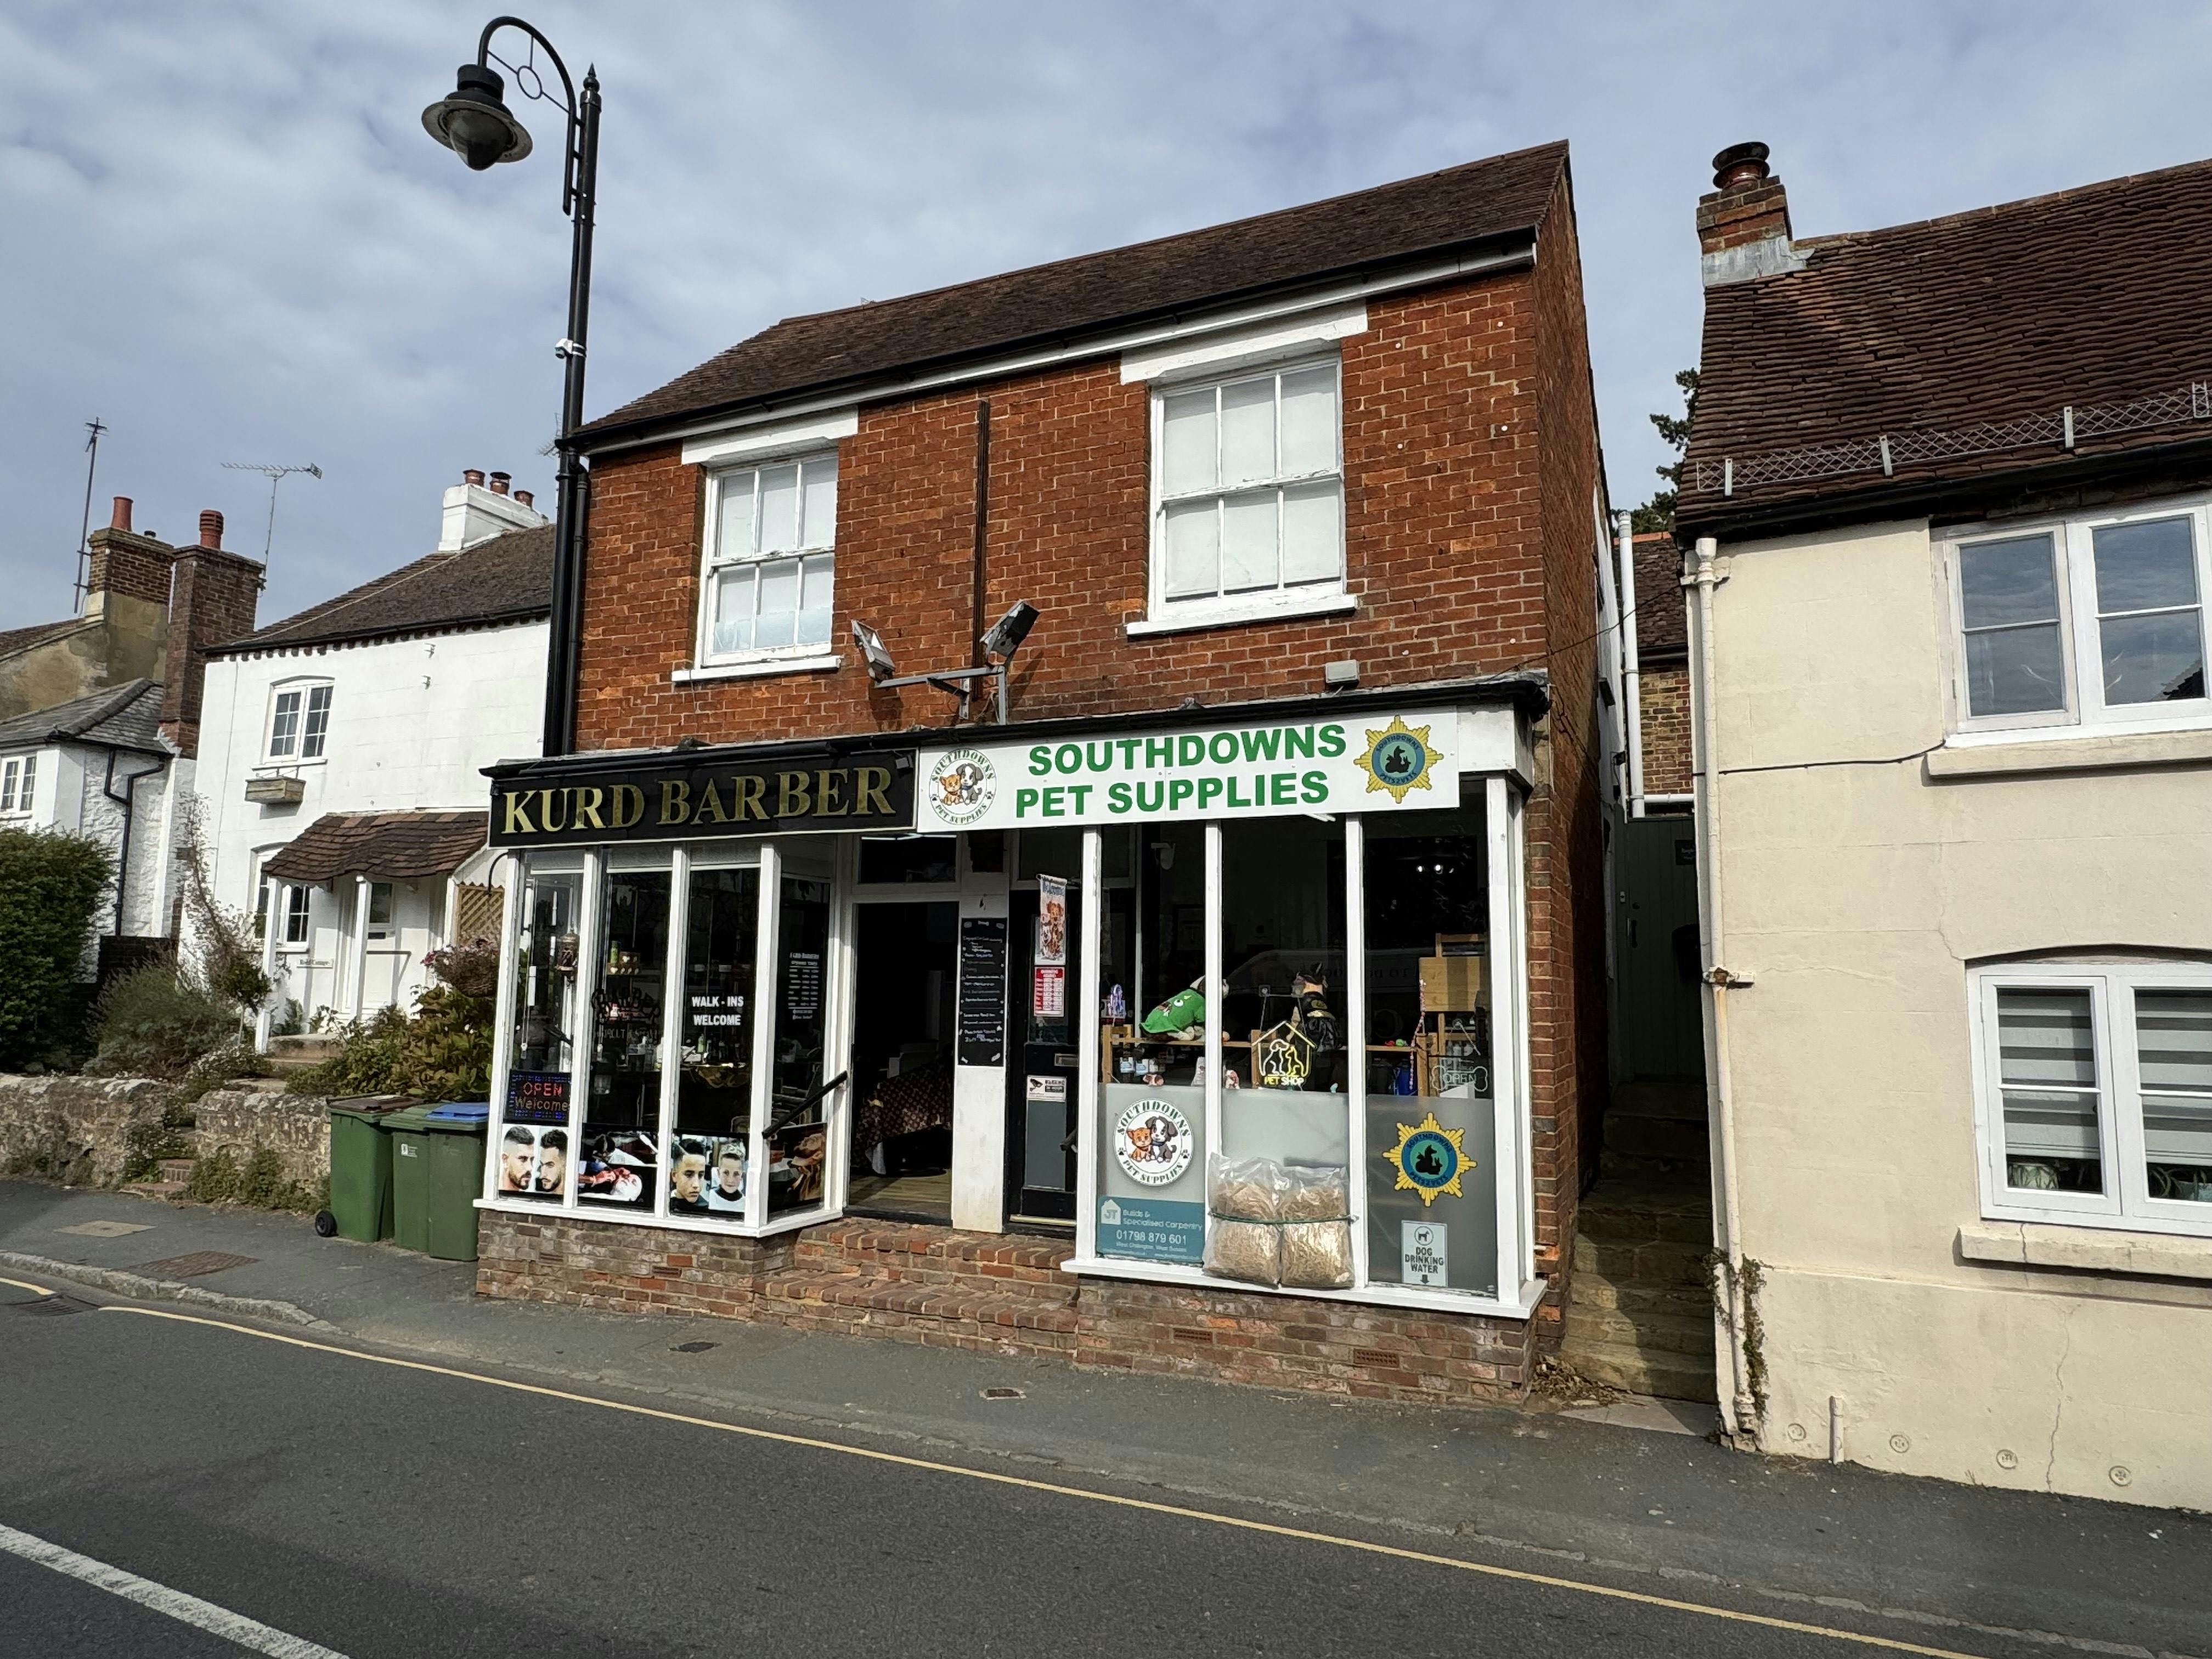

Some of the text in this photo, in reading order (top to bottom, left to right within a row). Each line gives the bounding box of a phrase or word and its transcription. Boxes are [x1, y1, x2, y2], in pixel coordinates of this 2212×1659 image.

[1029, 724, 1346, 776] SOUTHDOWNS
[1376, 735, 1421, 752] SOUTHDOWNS
[931, 749, 995, 783] SOUTHDOWNS
[500, 766, 896, 834] KURD BARBER
[1015, 771, 1330, 819] PET SUPPLIES
[935, 803, 987, 823] PET SUPPLIES
[691, 996, 720, 1007] WALK
[727, 995, 744, 1007] INS
[693, 1014, 741, 1026] WELCOME
[1264, 1076, 1305, 1086] PET SHOP
[1443, 1073, 1477, 1084] OPEN
[523, 1081, 562, 1096] OPEN
[515, 1096, 568, 1111] Welcome
[1117, 1101, 1190, 1137] SOUTHDOWNS
[1407, 1133, 1453, 1153] SOUTHDOWNS
[1122, 1159, 1183, 1183] PET SUPPLIES
[1104, 1209, 1118, 1220] JT
[1122, 1218, 1203, 1232] Specialised Carpentry
[1116, 1229, 1187, 1245] 01798 879 601
[1415, 1246, 1433, 1256] DOG
[1404, 1254, 1444, 1266] DRINKING
[1410, 1263, 1438, 1274] WATER
